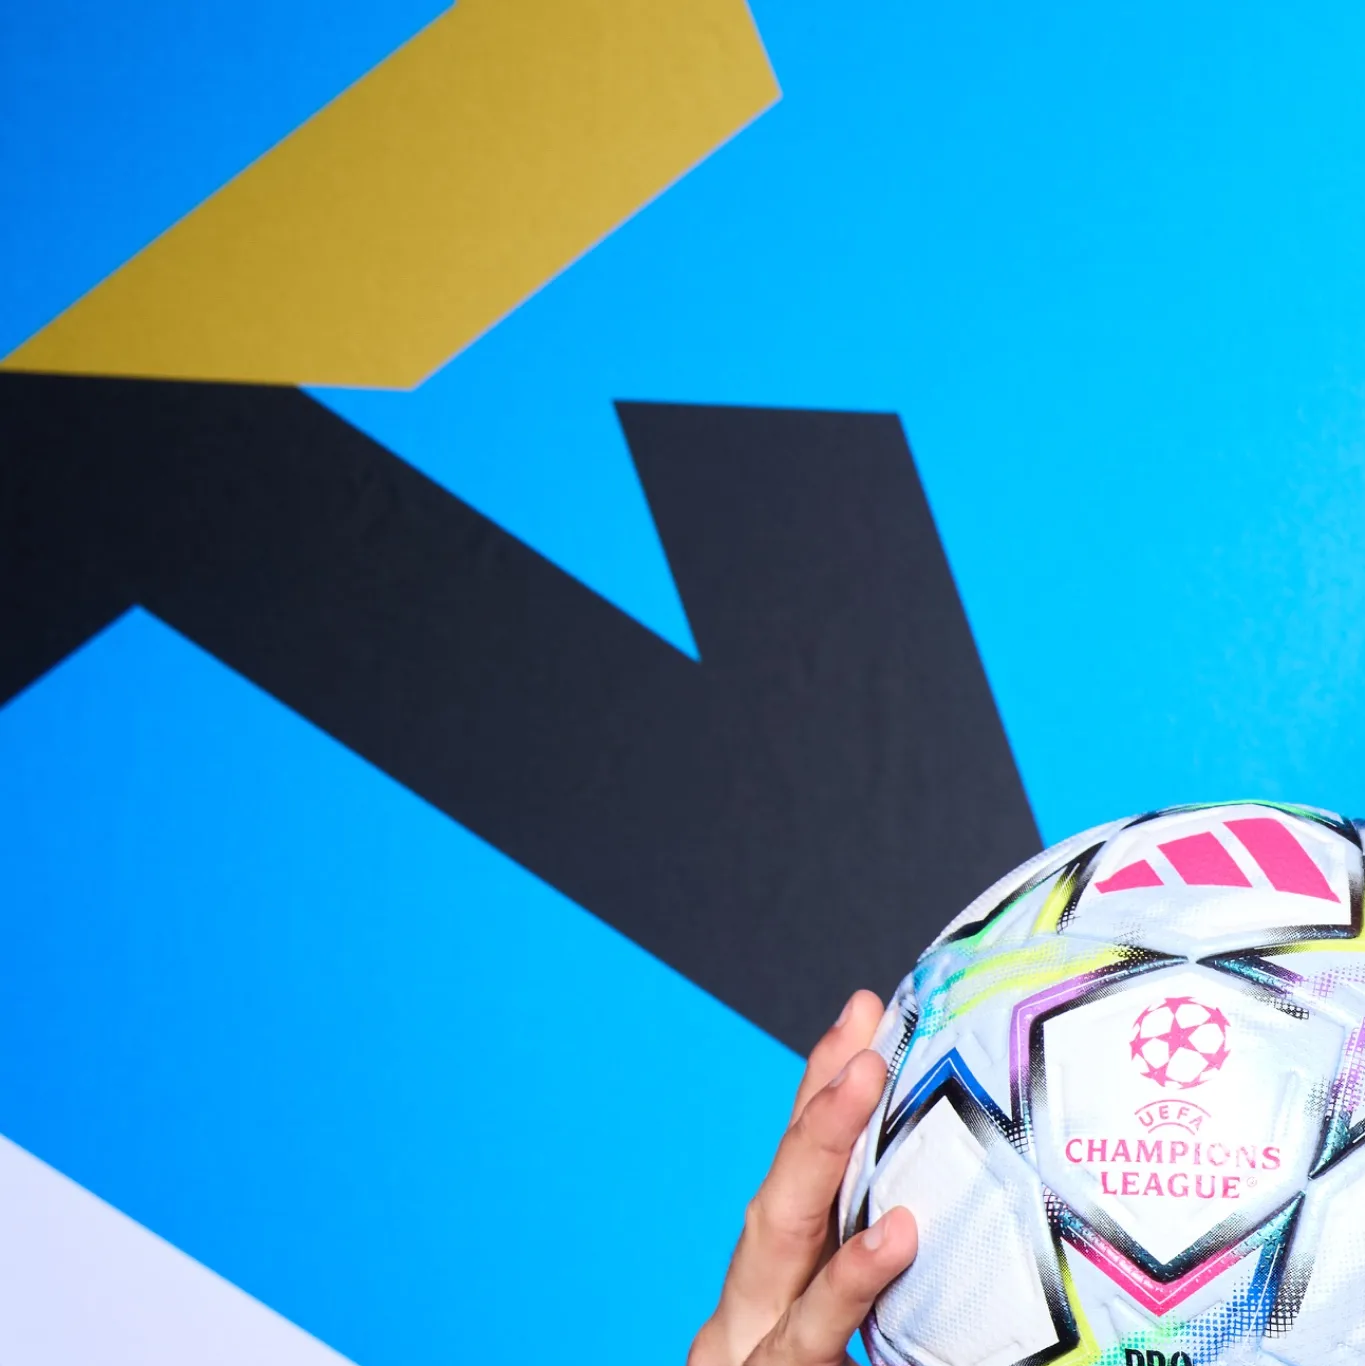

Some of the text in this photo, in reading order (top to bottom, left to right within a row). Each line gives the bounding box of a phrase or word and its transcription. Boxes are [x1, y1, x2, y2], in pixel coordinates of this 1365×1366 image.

[1138, 1104, 1204, 1131] UEFA
[1065, 1138, 1281, 1170] CHAMPIONS
[1101, 1171, 1241, 1199] LEAGUE
